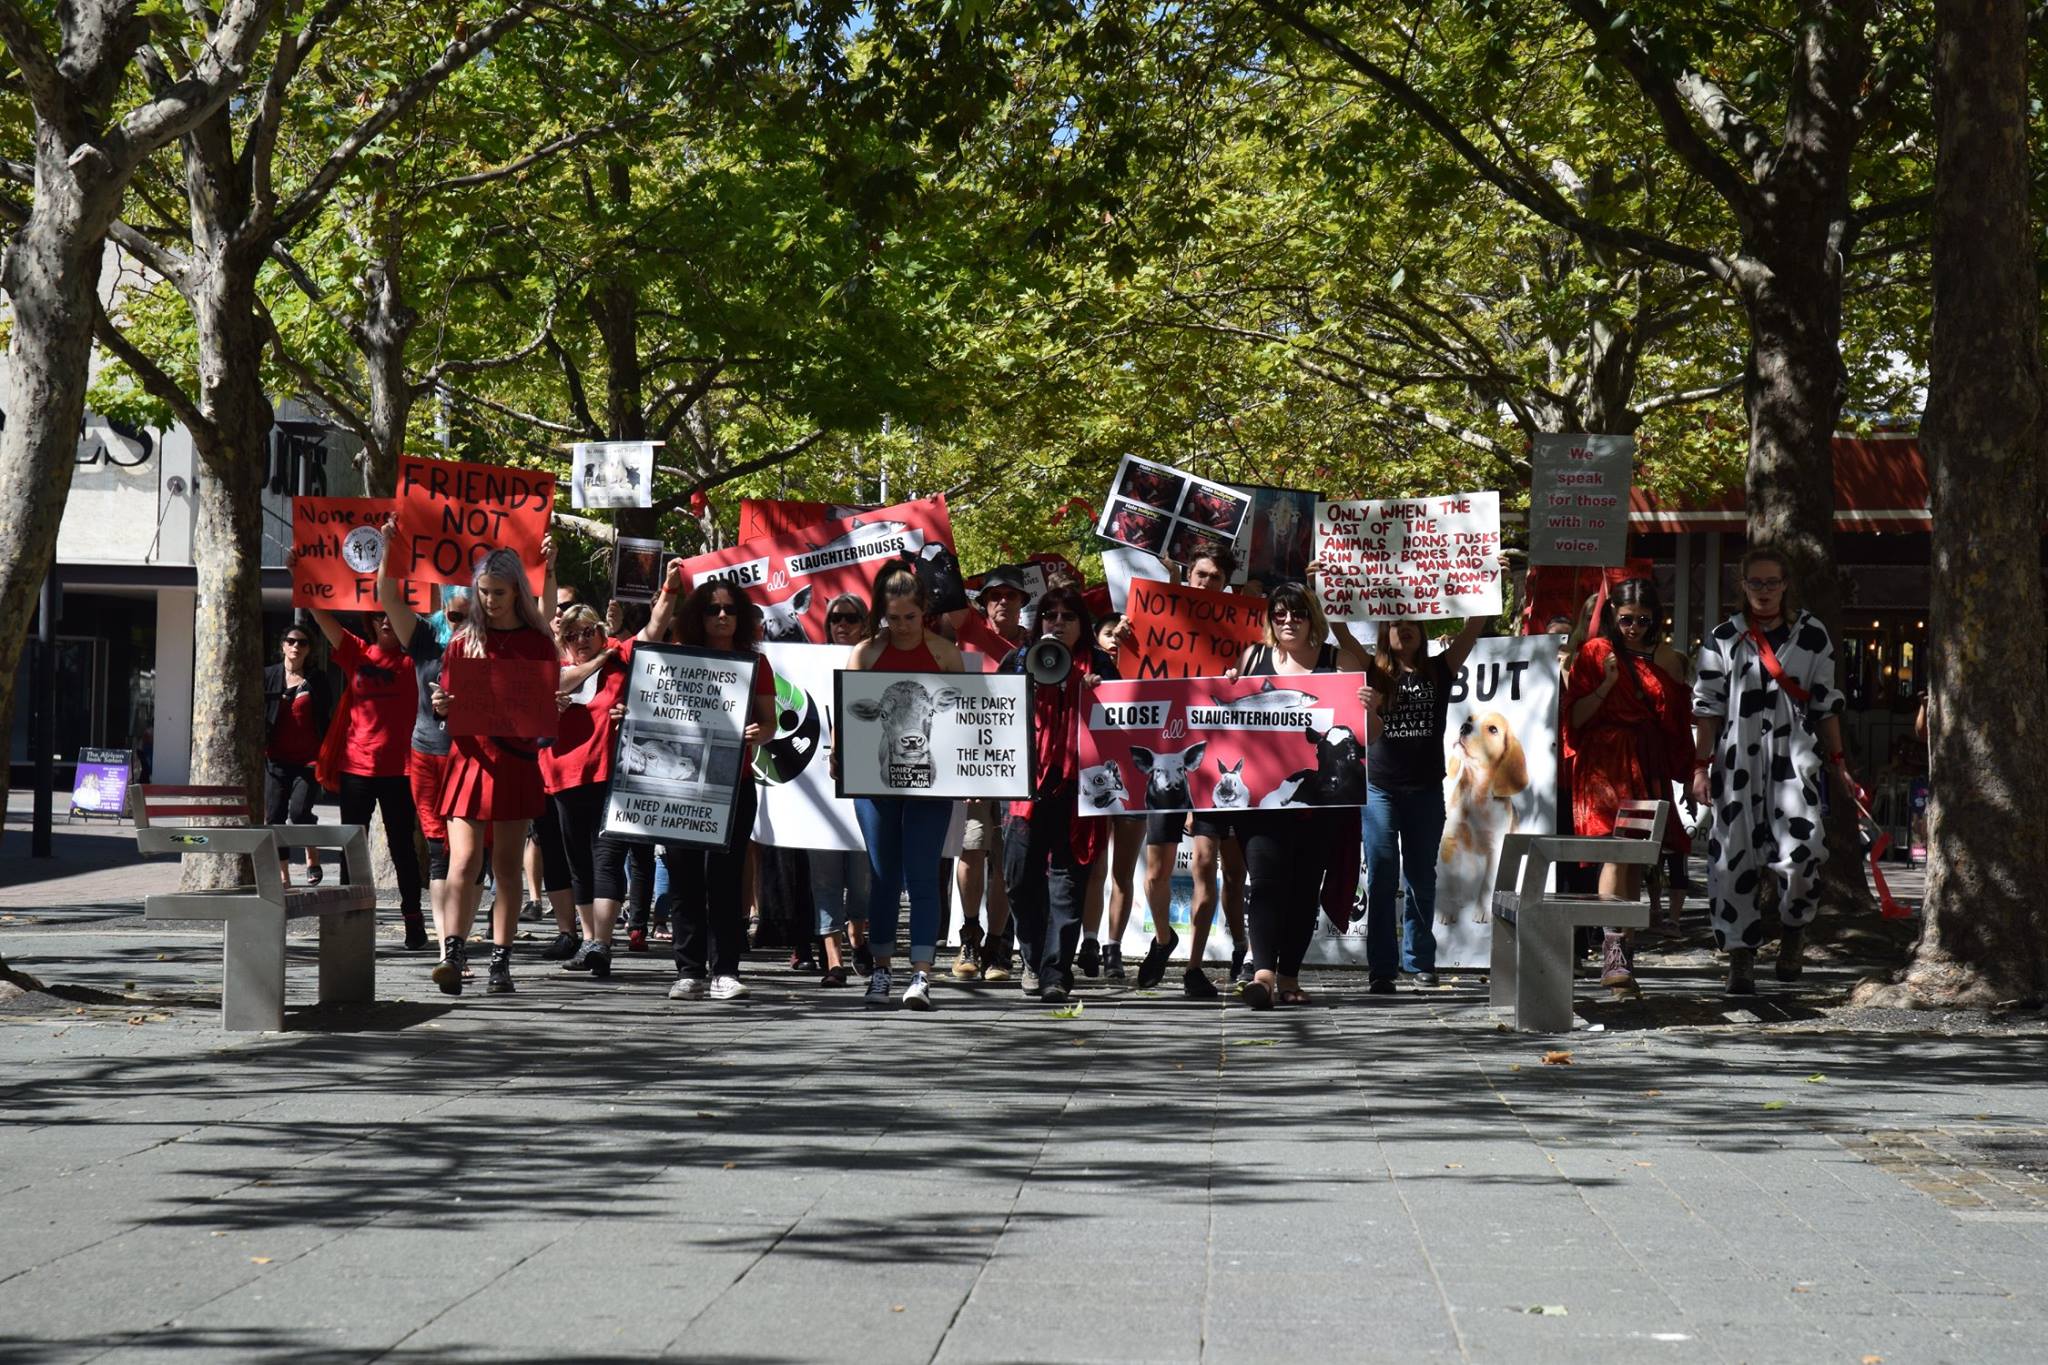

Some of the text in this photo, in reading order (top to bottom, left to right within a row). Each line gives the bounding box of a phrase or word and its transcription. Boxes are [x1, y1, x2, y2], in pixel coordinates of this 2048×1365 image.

[1570, 448, 1594, 460] We
[403, 463, 549, 512] FRIENDS
[1557, 473, 1603, 486] speak
[1549, 494, 1617, 507] for those
[300, 503, 355, 525] None
[1327, 500, 1471, 521] ONLY WHEN THE
[442, 505, 509, 540] NOT
[1319, 519, 1437, 536] LAST OF THE
[1549, 516, 1605, 528] with no
[296, 534, 340, 560] until
[1324, 532, 1499, 550] ANIMALS HORNS, TUSKS
[1555, 539, 1598, 551] voice.
[411, 534, 520, 577] FOO
[1319, 545, 1492, 564] SKIN AND BONES ARE
[767, 570, 789, 592] all
[791, 536, 905, 573] SLAUGHTERHOUSES
[1366, 563, 1403, 575] WILL
[1416, 558, 1483, 572] MANKIND
[1324, 570, 1499, 588] REALIZE THAT MONEY
[302, 582, 336, 599] are
[1324, 584, 1484, 602] CAN NEVER BUY BACK
[1134, 587, 1180, 616] NOT
[1180, 592, 1237, 625] YOUR
[1324, 601, 1450, 616] OUR WILDLIFE.
[1146, 625, 1198, 653] NOT
[646, 663, 737, 684] IF MY HAPPINESS
[1450, 661, 1529, 703] BUT
[656, 678, 722, 696] DEPENDS ON
[640, 690, 737, 712] THE SUFFERING OF
[955, 696, 1017, 710] THE DAIRY
[955, 712, 1016, 726] INDUSTRY
[1104, 704, 1313, 740] CLOSE all SLAUGHTERHOUSES
[1383, 711, 1434, 722] OBJECTS
[1384, 720, 1434, 731] SLAVES
[978, 728, 993, 746] IS
[1385, 729, 1433, 739] MACHINES
[956, 748, 1016, 762] THE MEAT
[956, 764, 1017, 777] INDUSTRY
[910, 780, 930, 788] MUM
[626, 797, 713, 819] I NEED ANOTHER
[615, 811, 640, 824] KIND
[644, 815, 657, 826] OF
